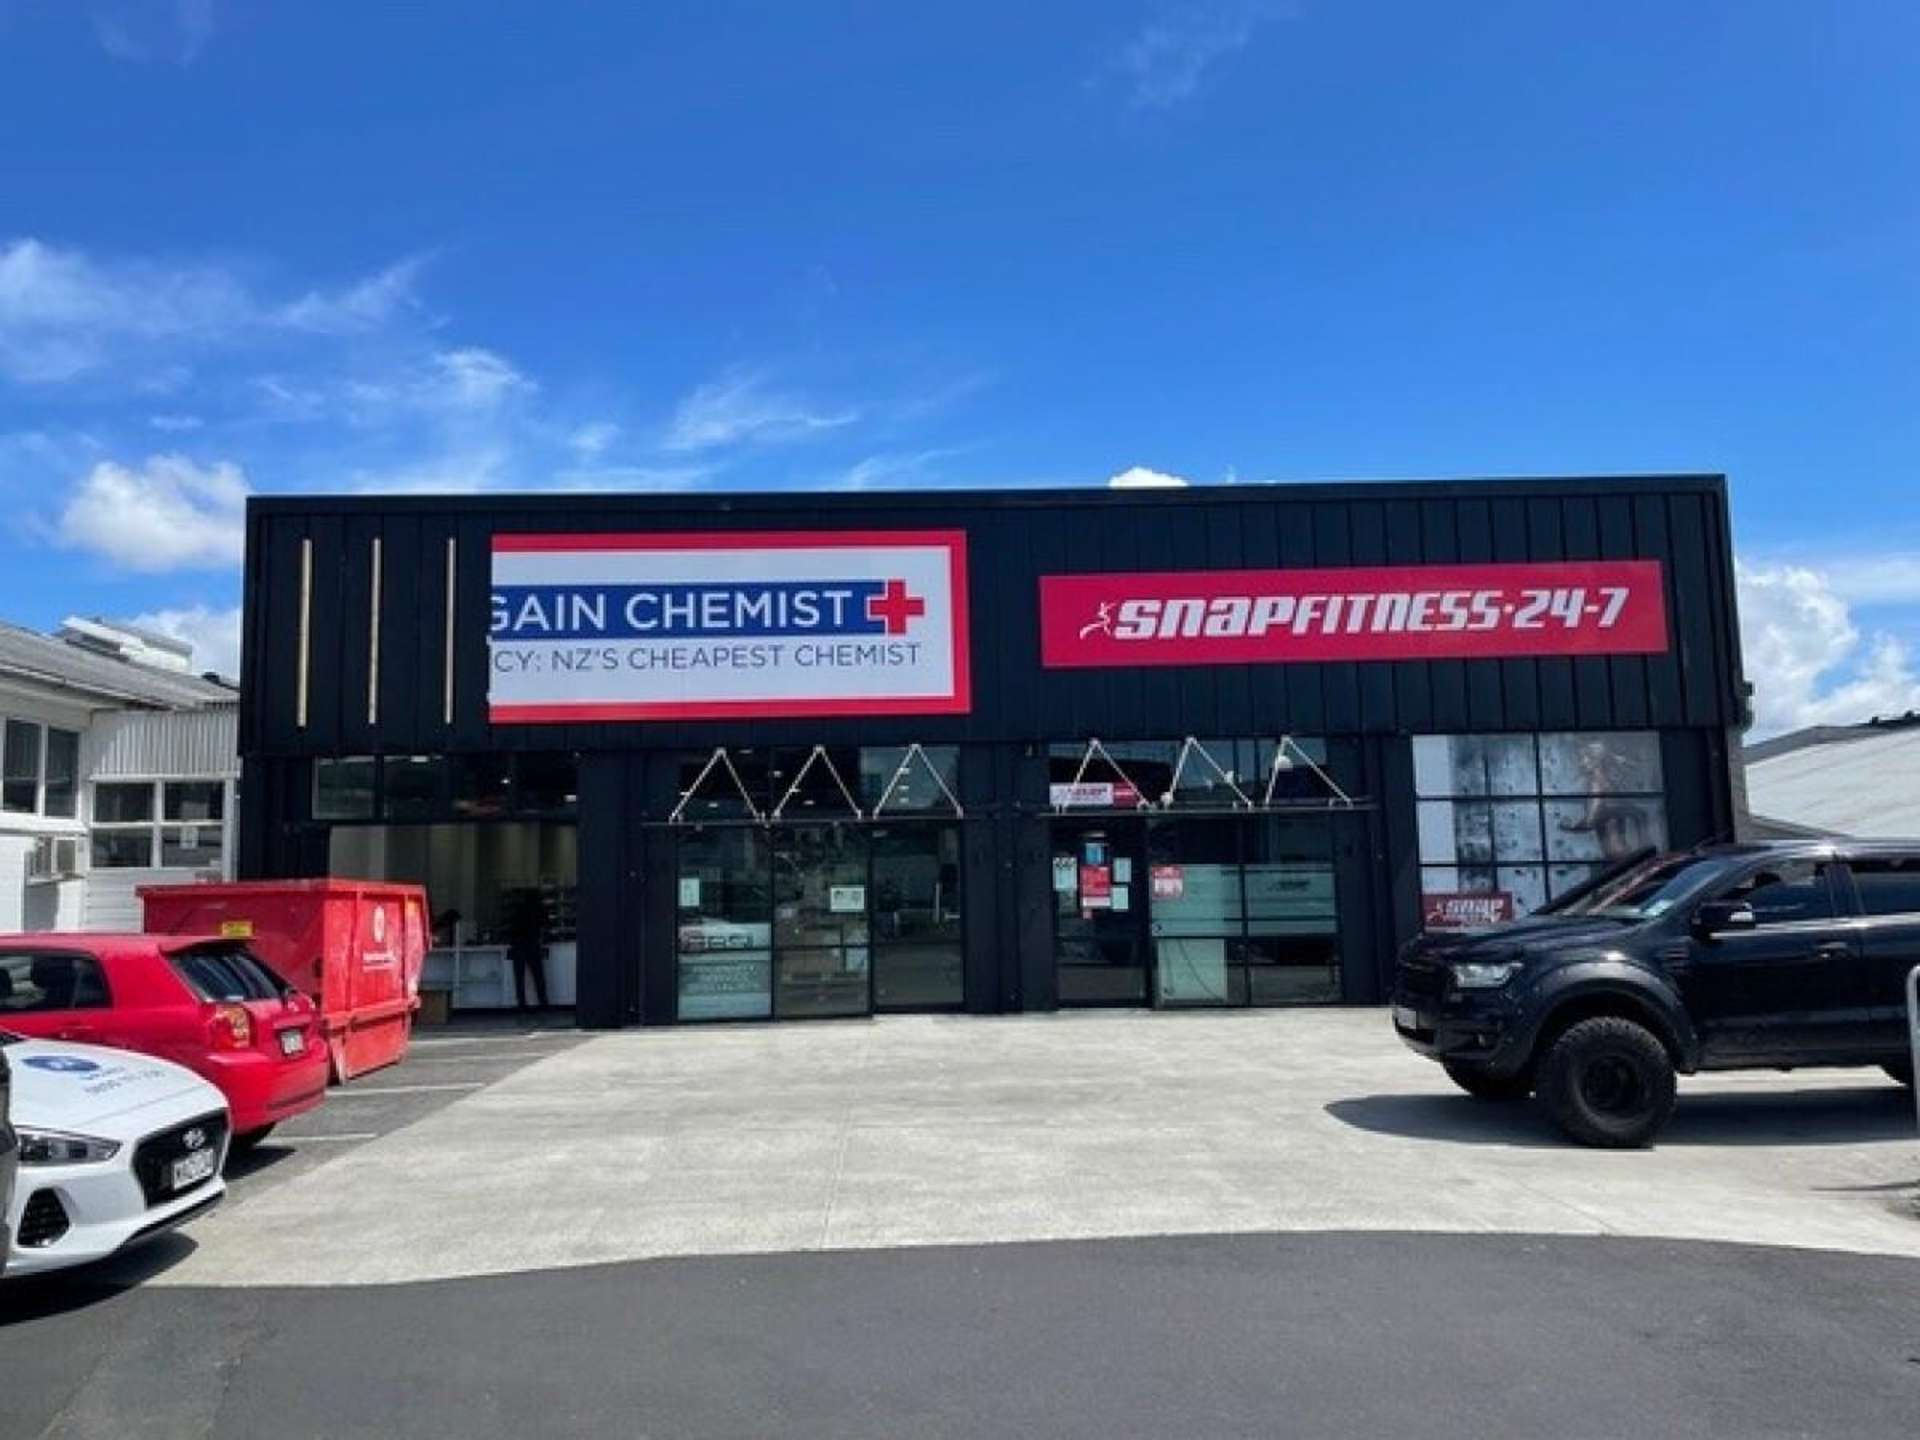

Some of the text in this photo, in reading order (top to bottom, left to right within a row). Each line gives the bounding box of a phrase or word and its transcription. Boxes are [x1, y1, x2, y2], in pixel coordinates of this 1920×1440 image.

[626, 590, 853, 630] CHEMIST
[552, 647, 619, 670] NZ'S
[628, 645, 783, 670] CHEAPEST
[794, 642, 921, 667] CHEMIST
